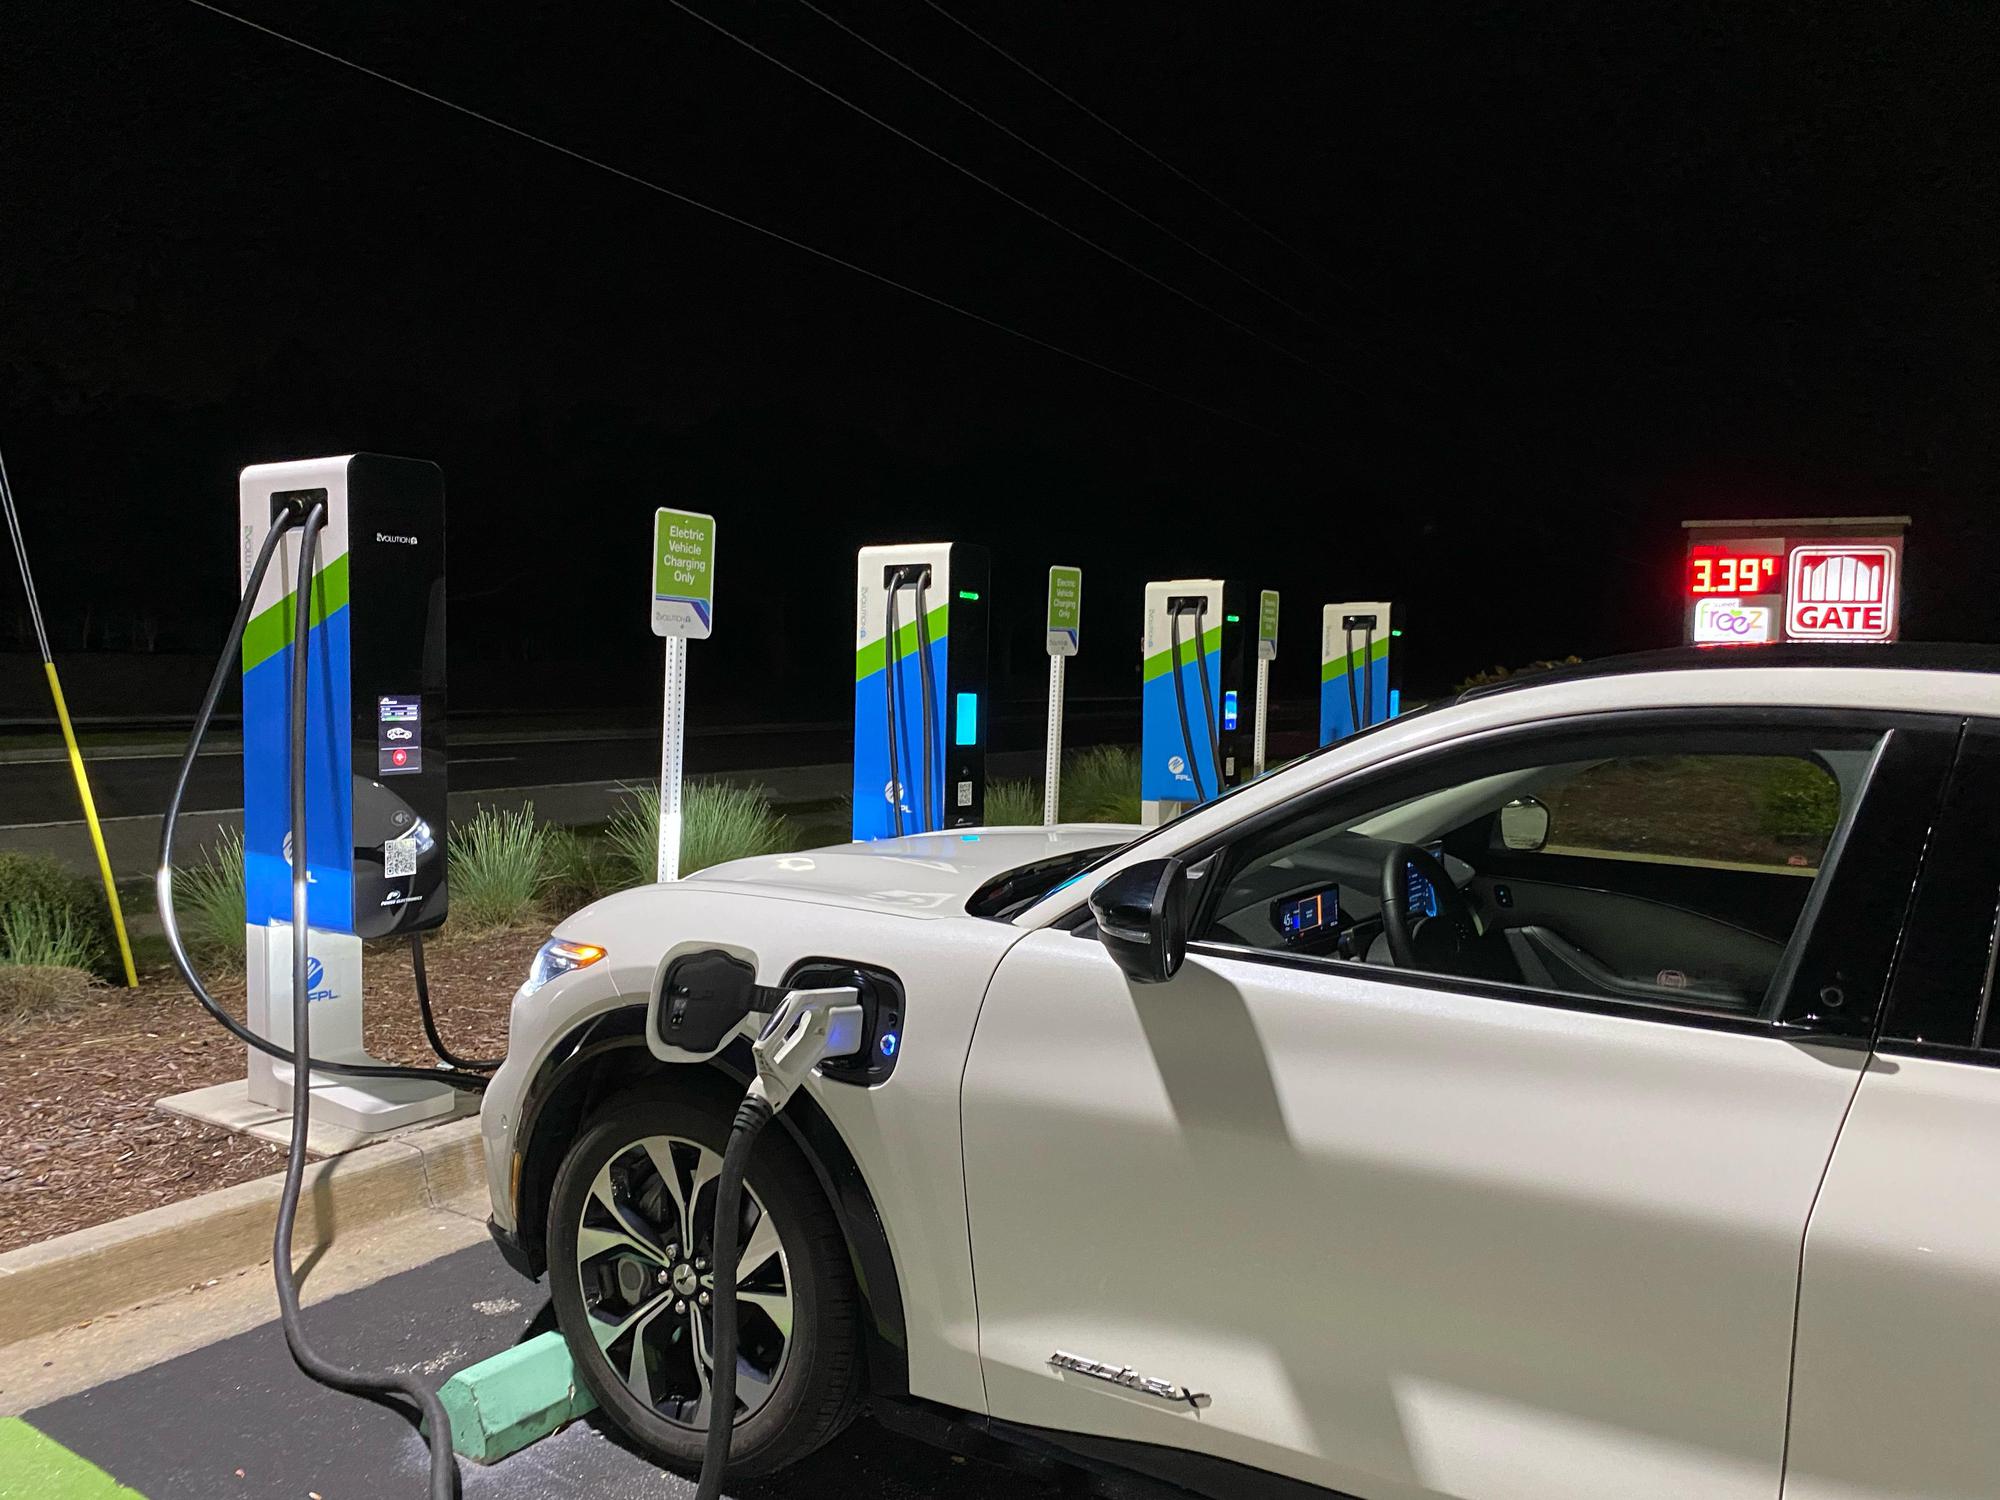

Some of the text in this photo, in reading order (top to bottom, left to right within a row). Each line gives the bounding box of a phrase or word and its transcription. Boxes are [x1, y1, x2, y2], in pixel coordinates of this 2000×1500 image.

[670, 526, 704, 541] Electric
[244, 525, 253, 583] EVOLUTIO
[669, 540, 701, 555] Vehicle
[663, 554, 706, 572] Charging
[674, 570, 695, 585] Only
[1796, 606, 1882, 629] GATE
